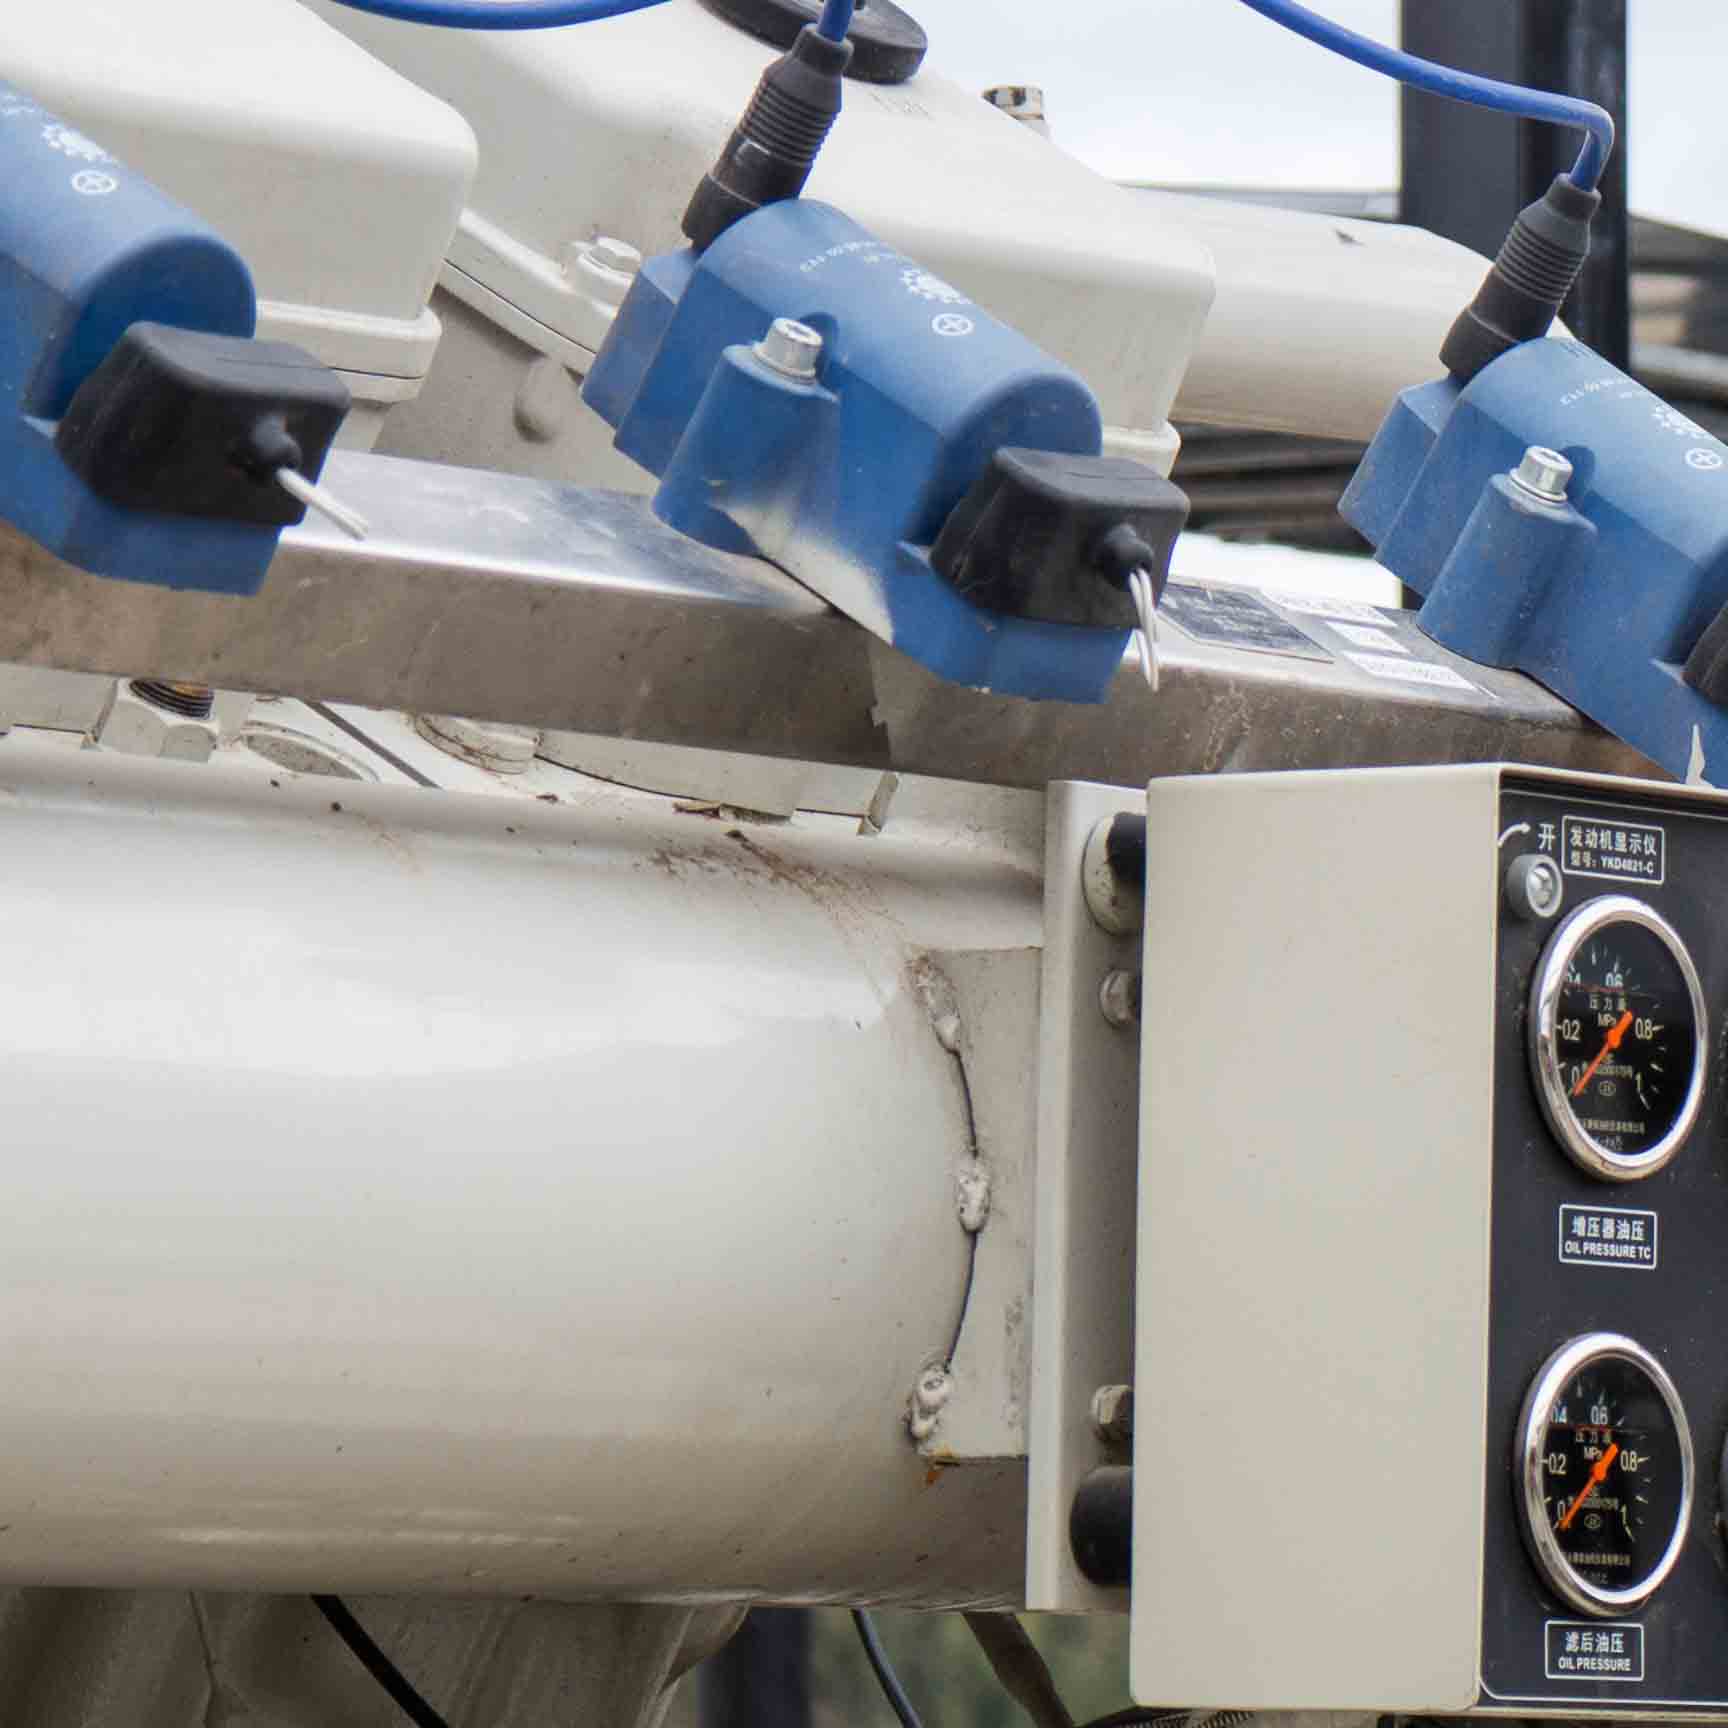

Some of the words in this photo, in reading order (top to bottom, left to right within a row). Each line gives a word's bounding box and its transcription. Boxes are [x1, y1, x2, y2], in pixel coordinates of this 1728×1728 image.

[1538, 823, 1557, 851] 开
[1564, 1240, 1582, 1255] OIL
[1583, 1241, 1636, 1259] PRESSURE
[1638, 1245, 1652, 1260] TC
[1558, 1655, 1576, 1670] OIL
[1576, 1657, 1632, 1672] PRESSURE
